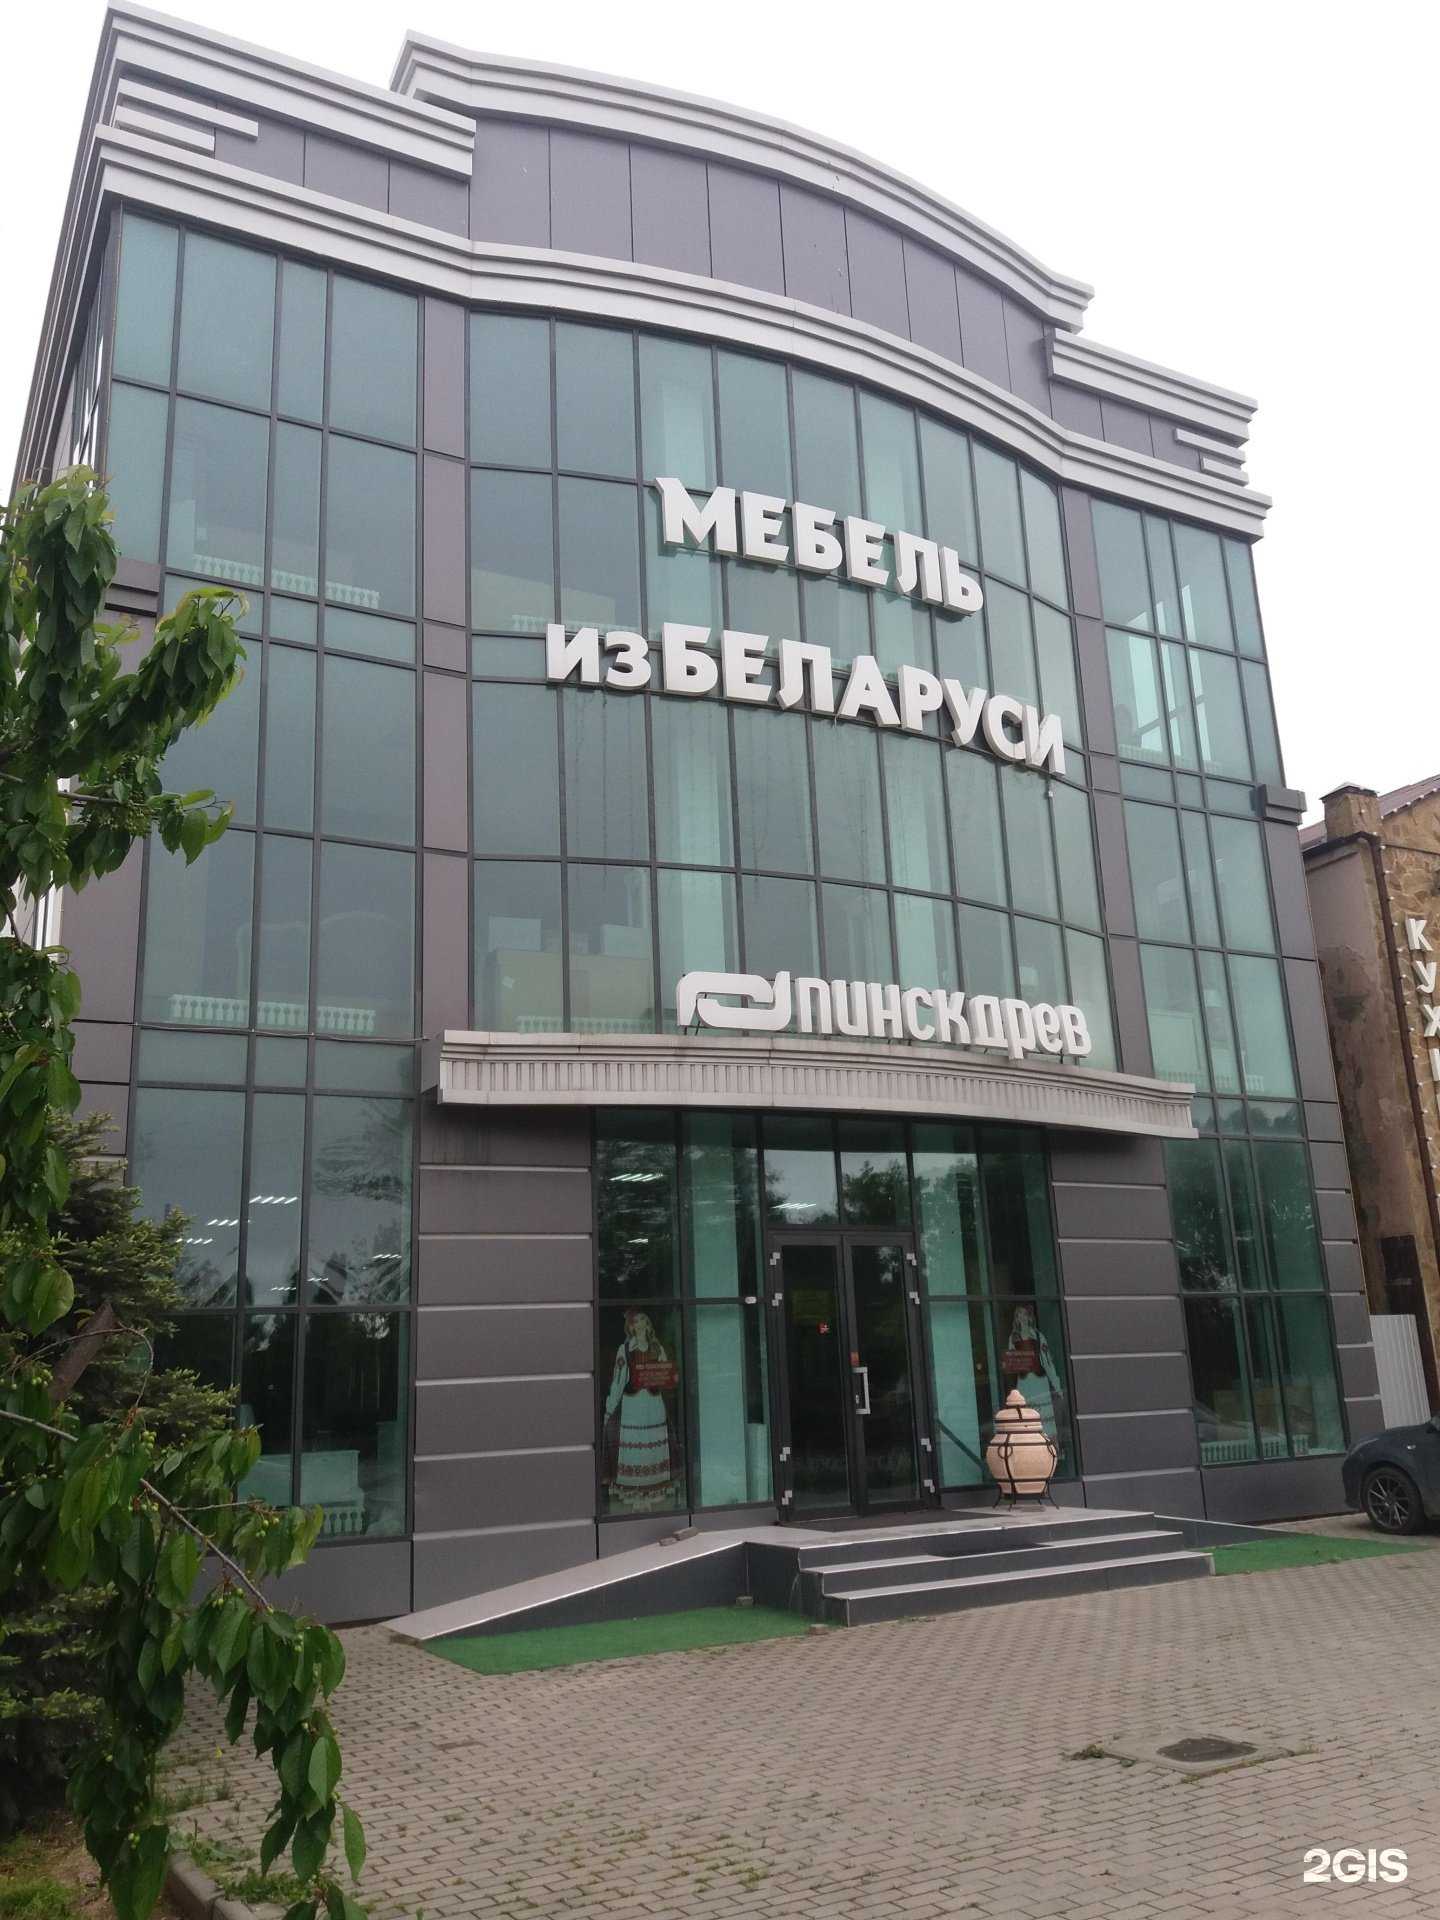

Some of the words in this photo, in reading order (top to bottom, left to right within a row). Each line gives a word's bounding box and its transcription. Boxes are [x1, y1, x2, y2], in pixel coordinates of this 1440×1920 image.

[655, 477, 984, 614] МЕБЕЛЬ
[546, 623, 652, 690] ИЗ
[662, 622, 1066, 776] БЕЛАРУСИ
